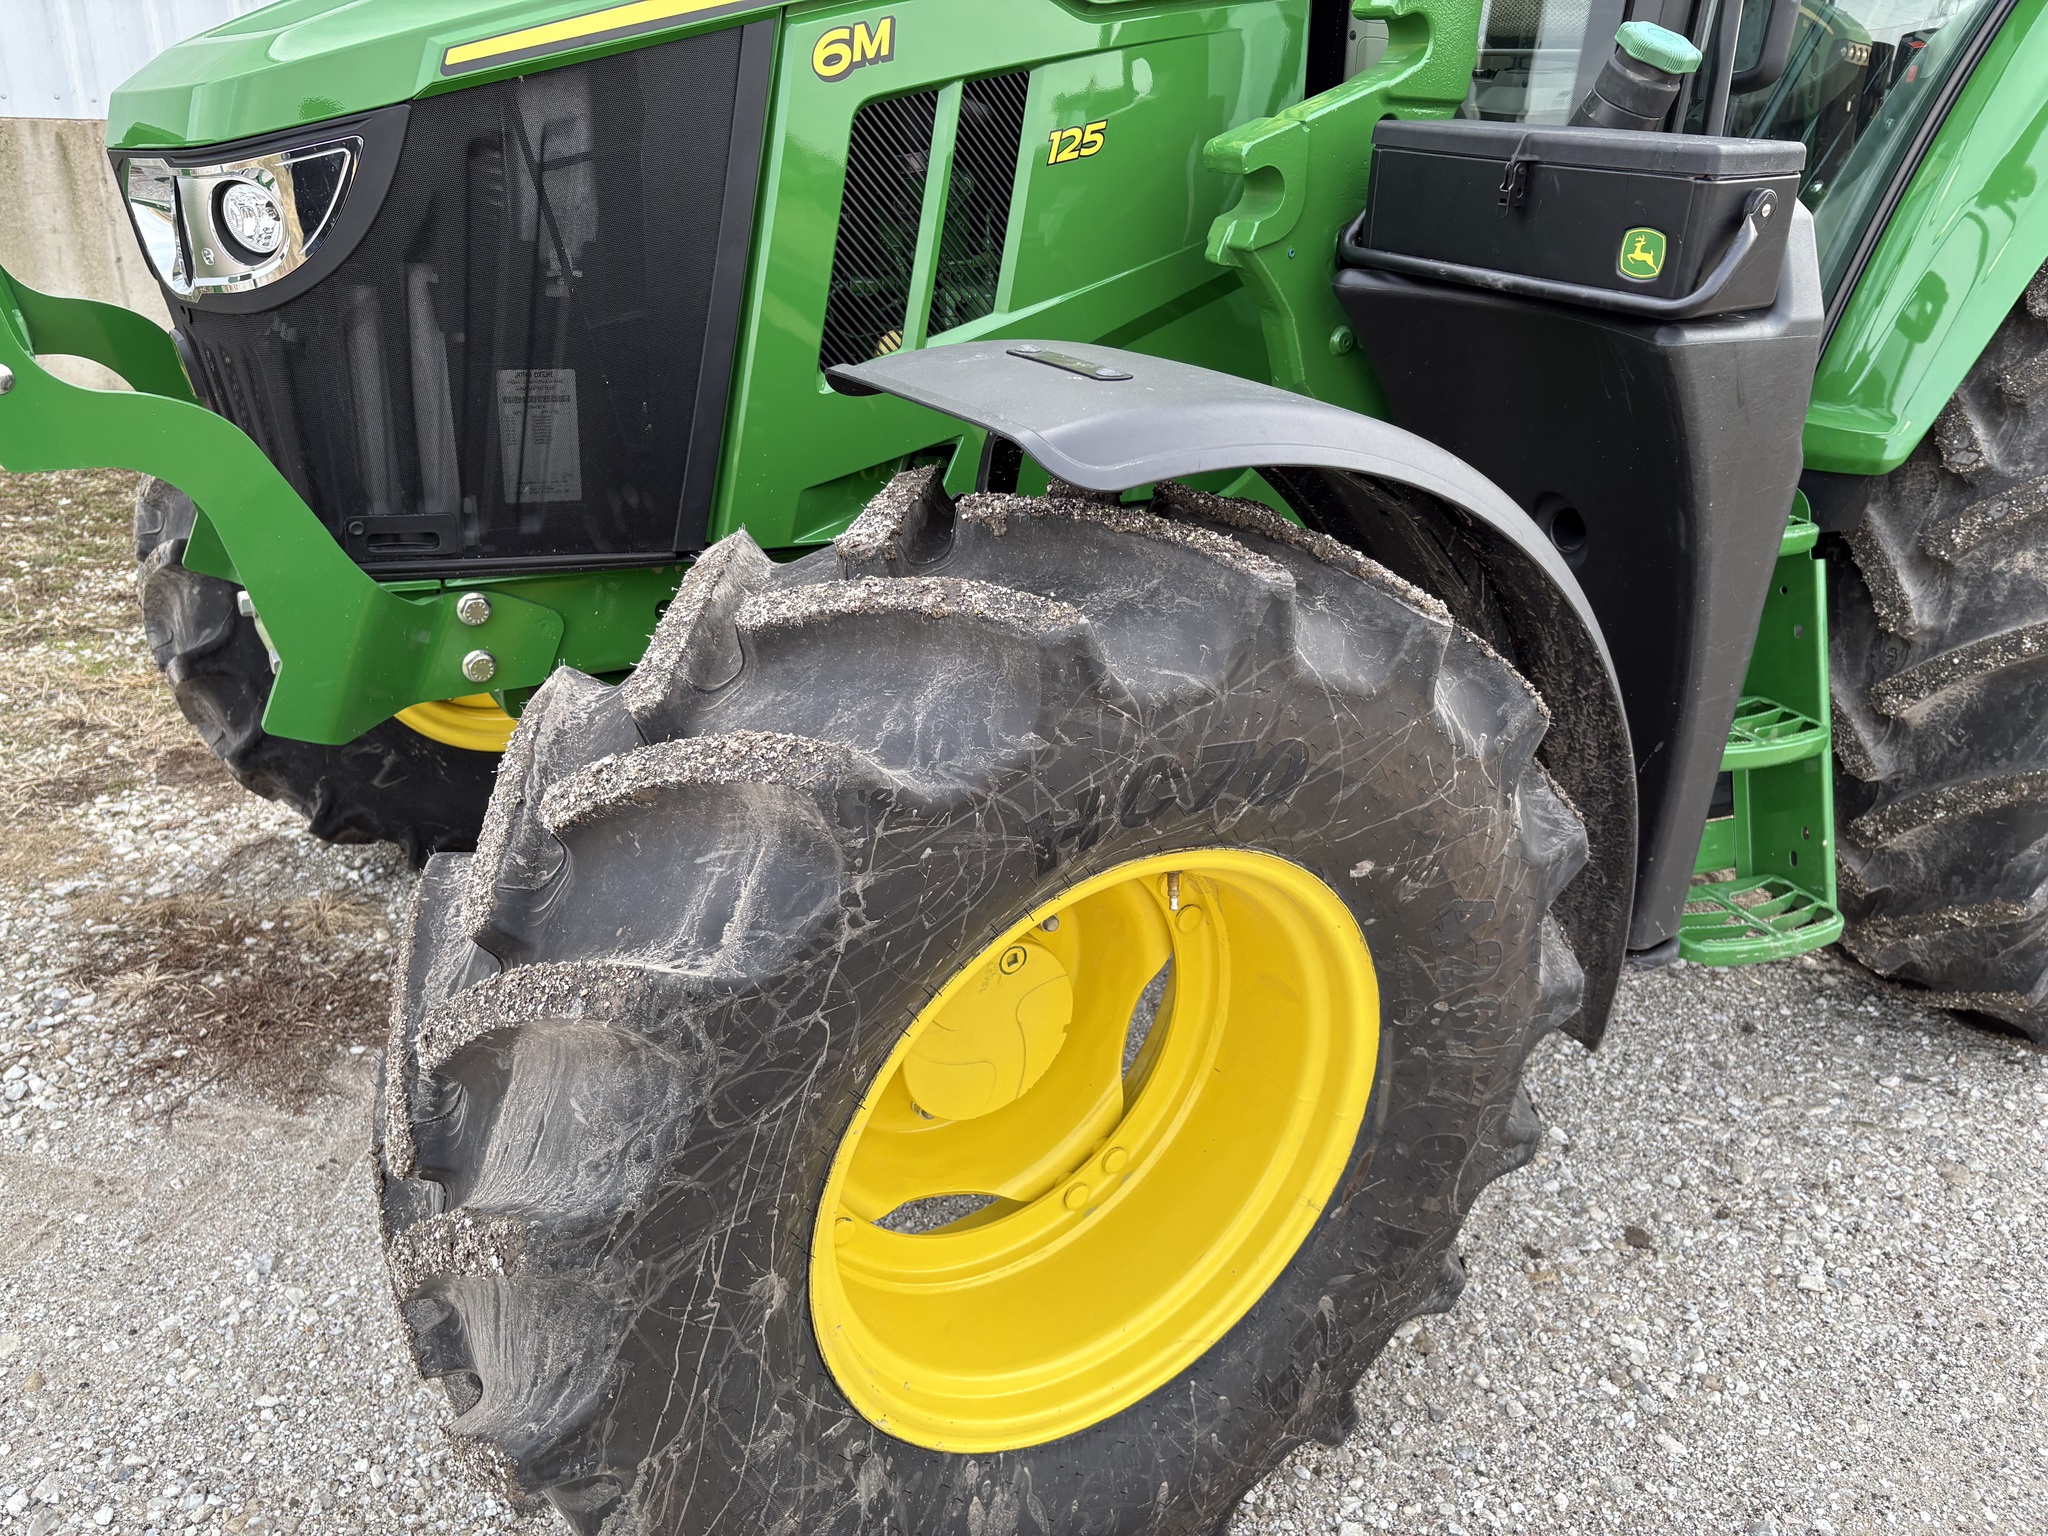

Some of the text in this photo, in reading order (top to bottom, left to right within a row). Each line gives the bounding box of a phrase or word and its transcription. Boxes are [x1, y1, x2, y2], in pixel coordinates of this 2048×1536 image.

[811, 15, 896, 83] 6M
[1046, 119, 1108, 166] 125
[1028, 738, 1310, 876] HC70
